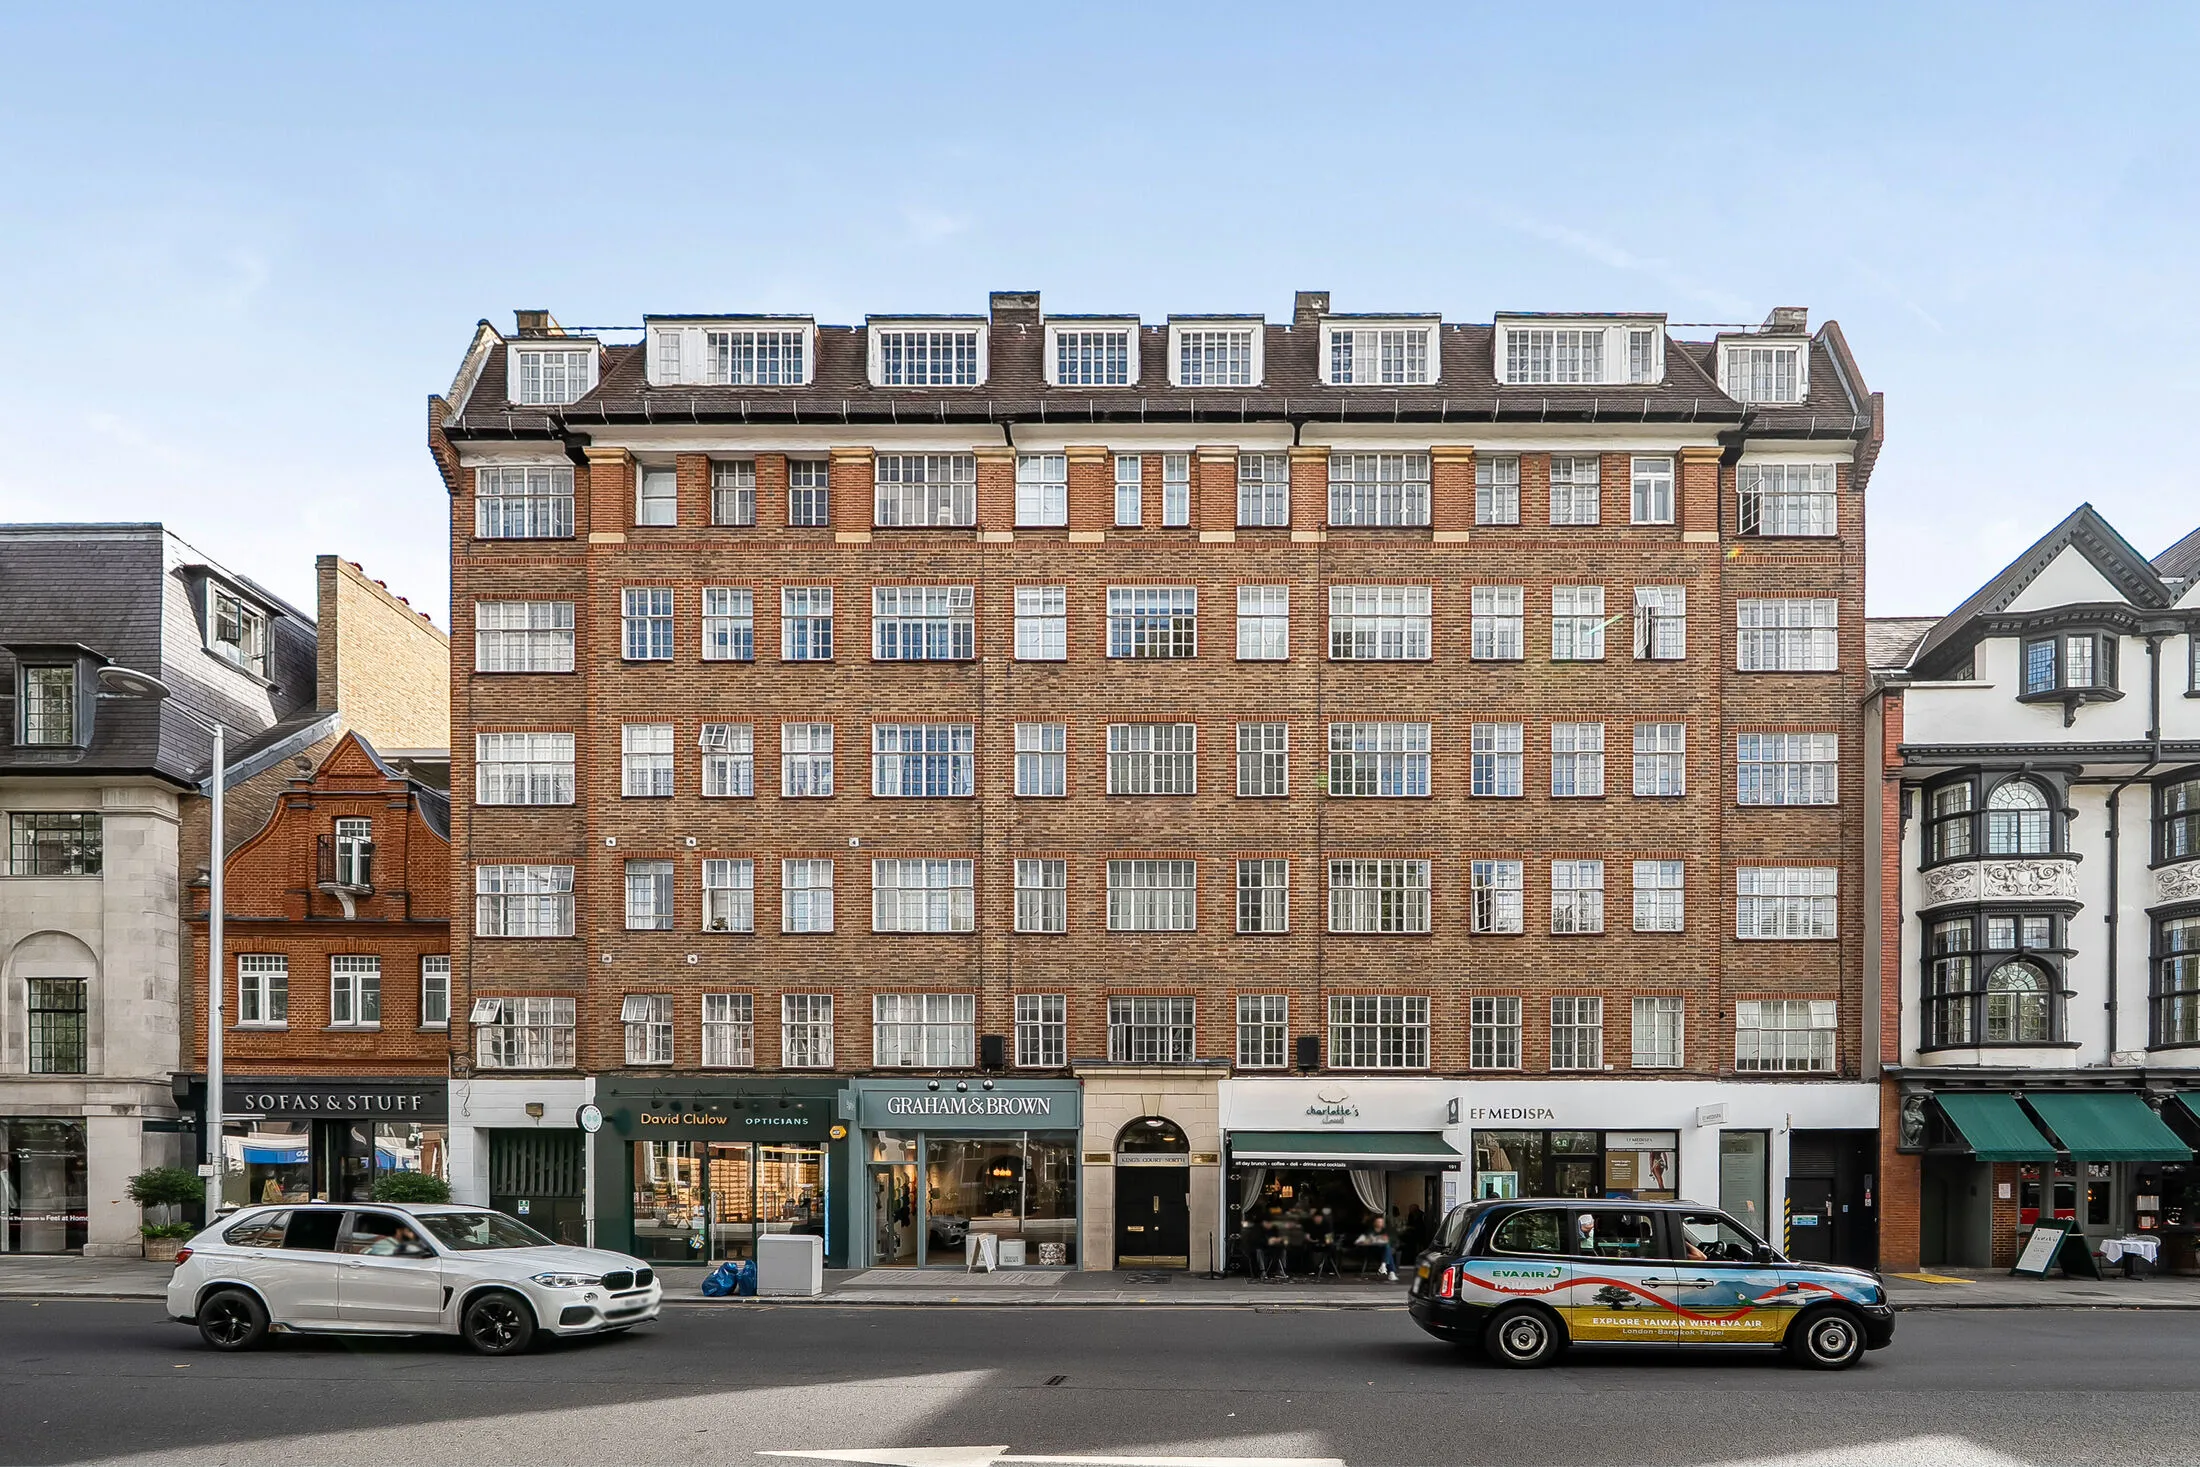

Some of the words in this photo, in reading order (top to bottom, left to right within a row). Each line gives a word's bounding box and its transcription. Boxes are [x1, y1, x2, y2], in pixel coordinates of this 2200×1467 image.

[245, 1094, 319, 1111] SOFAS
[326, 1095, 343, 1111] &
[347, 1095, 422, 1111] STUFF
[641, 1113, 679, 1125] David
[683, 1113, 728, 1125] Clulow
[745, 1118, 809, 1126] OPTICIANS
[1470, 1108, 1486, 1120] EF
[1488, 1108, 1555, 1120] MEDISPA
[1592, 1317, 1640, 1326] EXPLORE
[1643, 1318, 1686, 1327] TAIWAN
[1690, 1319, 1717, 1327] WITH
[1744, 1320, 1762, 1328] AIR
